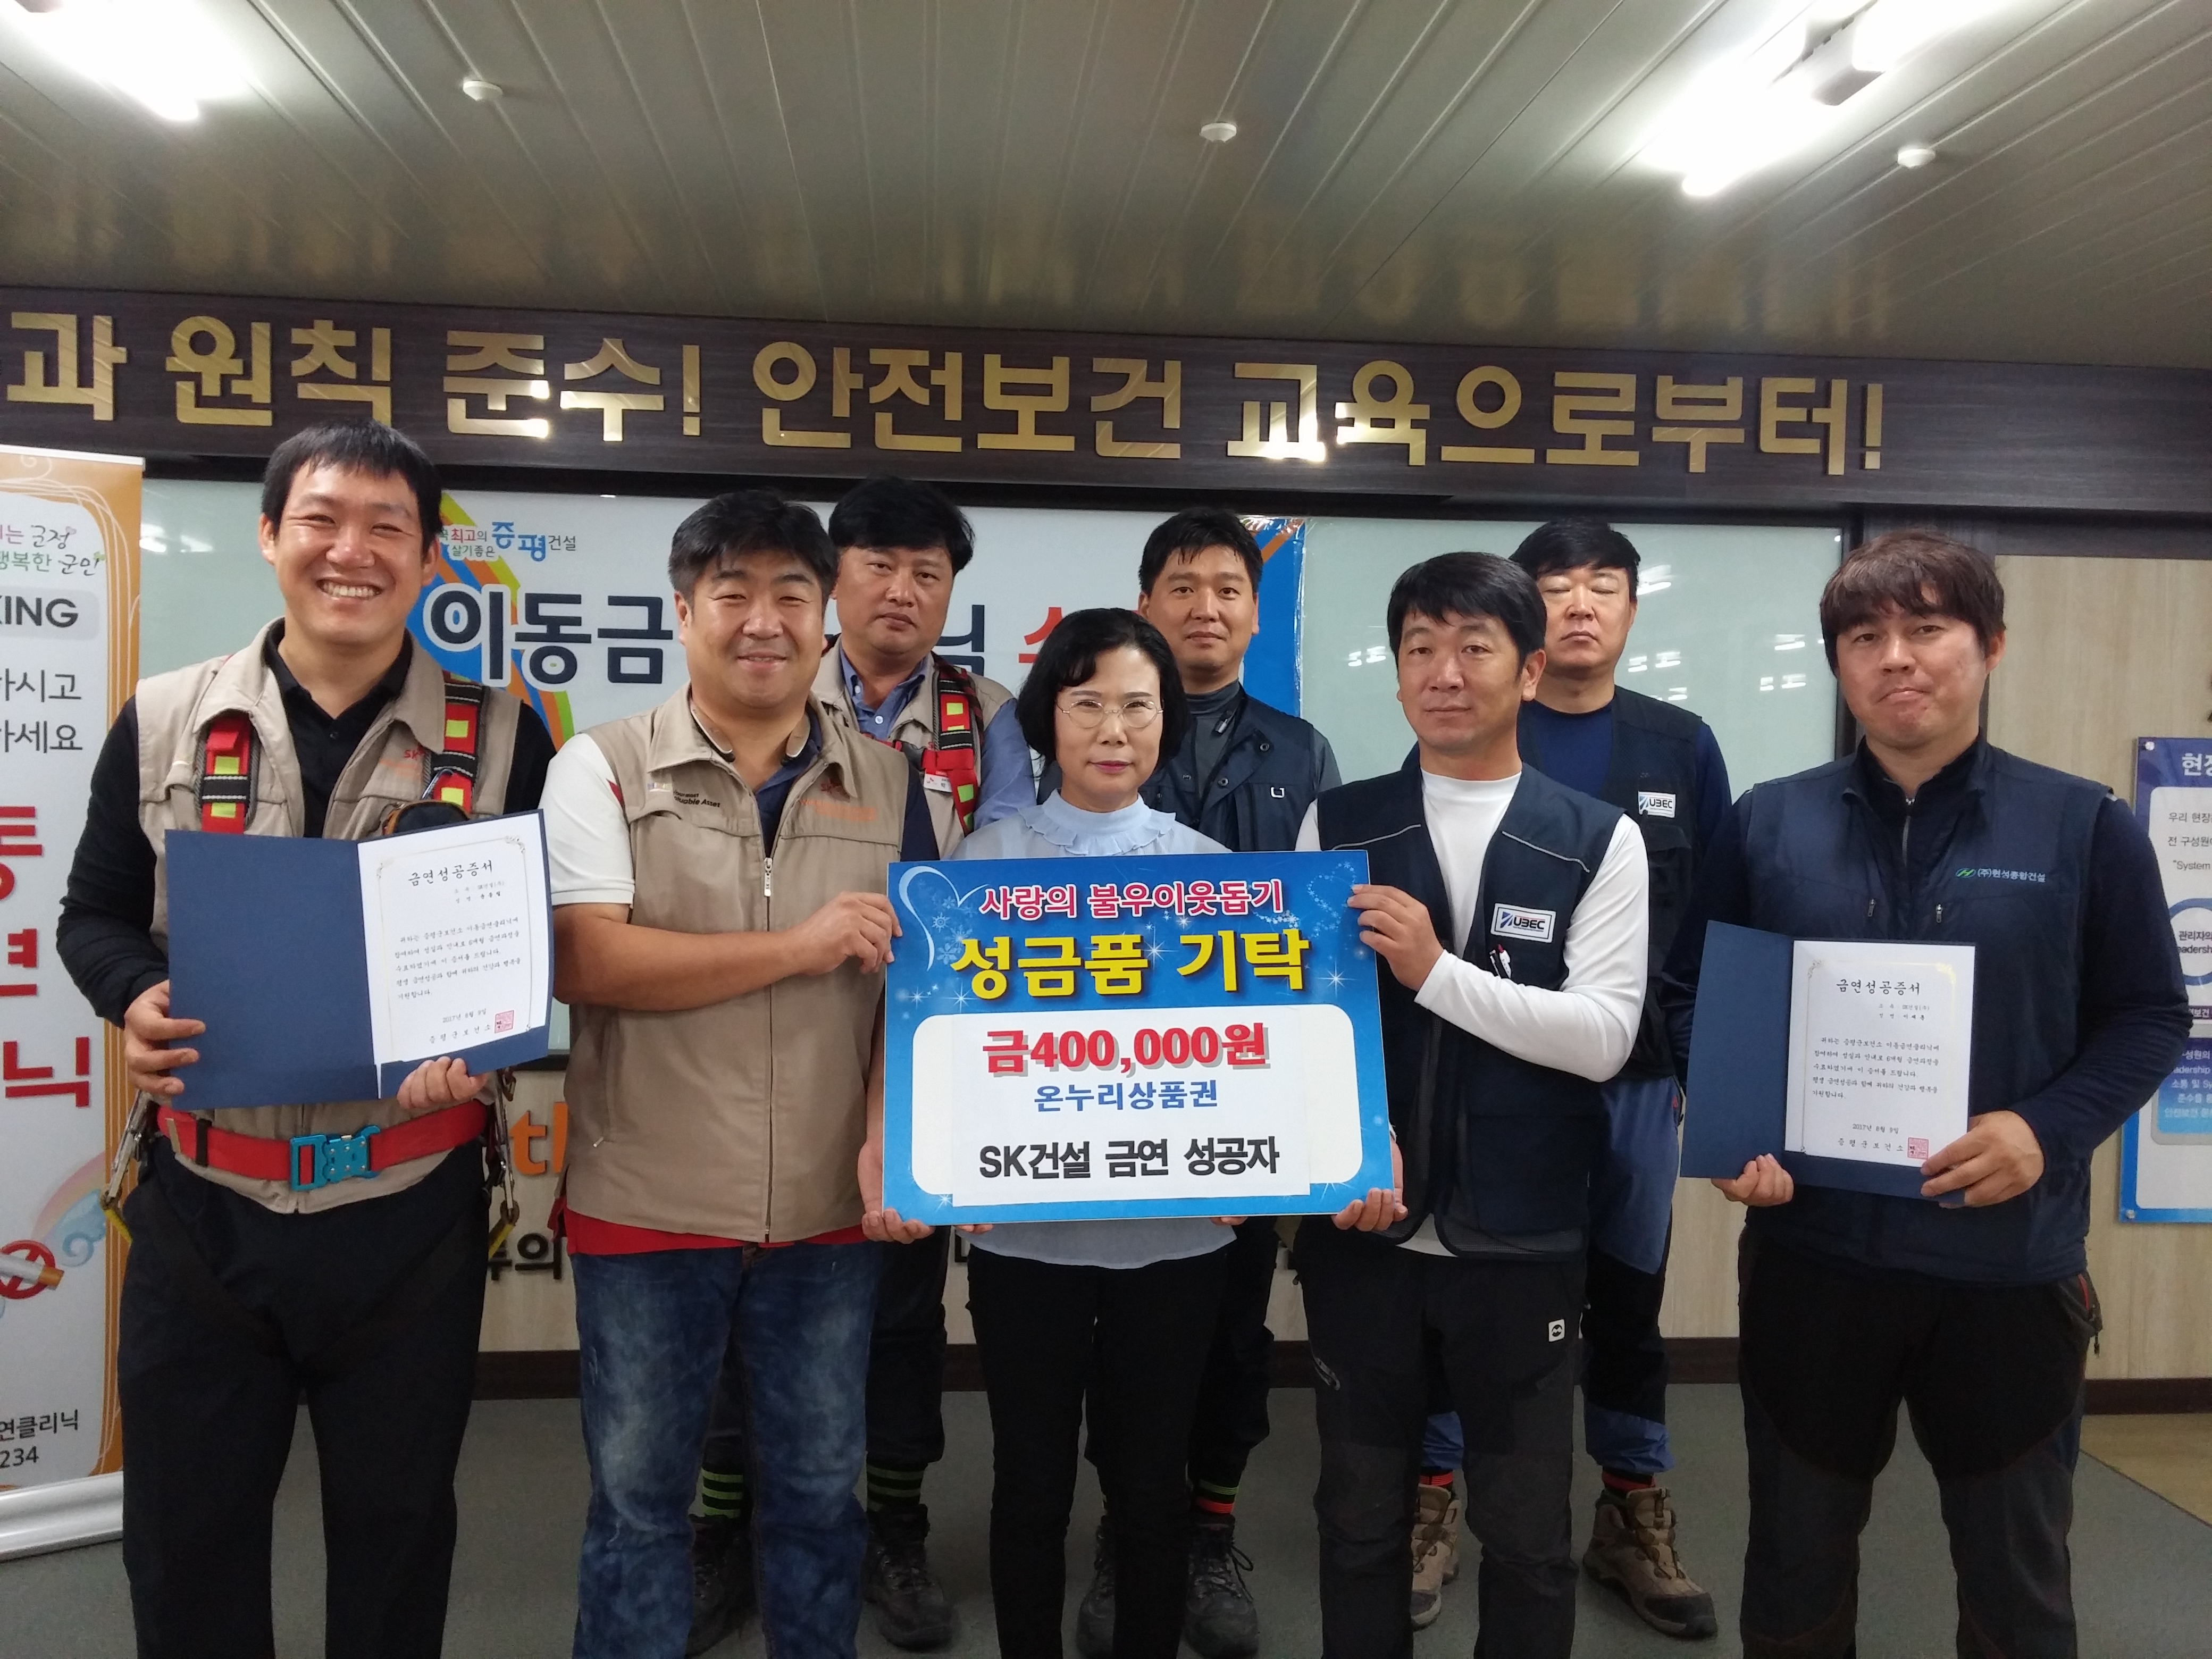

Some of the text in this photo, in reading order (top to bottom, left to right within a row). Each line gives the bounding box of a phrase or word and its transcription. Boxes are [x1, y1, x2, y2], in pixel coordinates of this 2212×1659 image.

[7, 312, 1882, 475] 과 원칙 준수! 안전보건 교육으로부터!
[492, 522, 546, 562] 증평
[548, 535, 576, 551] 건설
[57, 554, 99, 576] 군민
[0, 595, 79, 628] ING
[701, 799, 721, 808] Asset
[2169, 812, 2187, 823] 우리
[2168, 836, 2177, 847] 전
[408, 859, 492, 886] 금연성공증서
[979, 879, 1284, 920] 사랑의 불우이웃돕기
[950, 928, 1312, 1001] 성금품 기탁
[1836, 979, 1920, 996] 금연성공증서
[983, 1023, 1268, 1075] 금400,000원
[1034, 1080, 1218, 1113] 온누리상품권
[979, 1136, 1280, 1180] SK건설 금연 성공자
